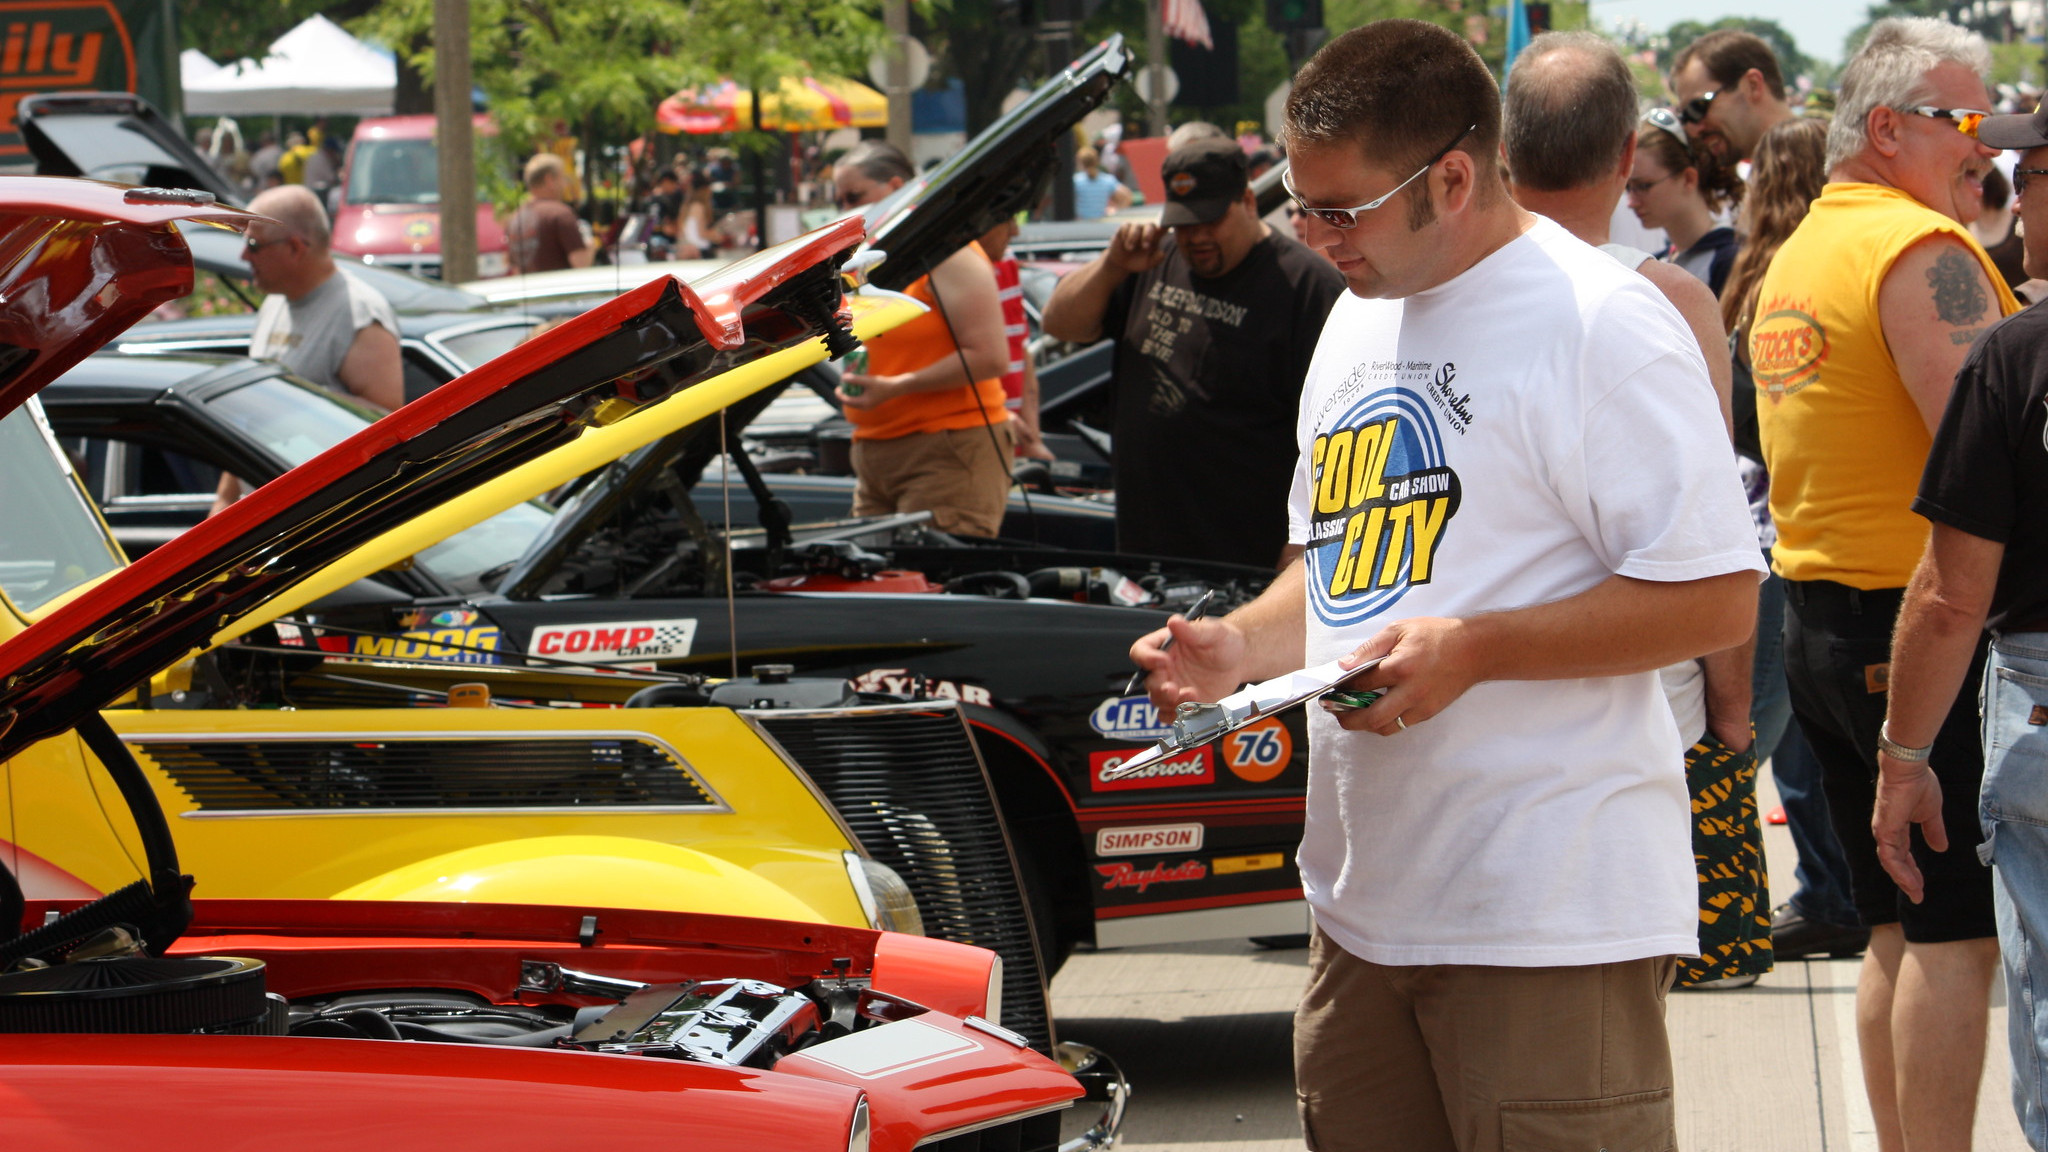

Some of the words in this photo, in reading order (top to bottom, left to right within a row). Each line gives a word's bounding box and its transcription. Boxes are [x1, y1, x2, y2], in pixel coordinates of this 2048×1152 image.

[0, 21, 103, 86] ily
[1401, 372, 1429, 380] UNION
[1435, 362, 1474, 425] Shoreline
[1313, 362, 1367, 432] iverside
[1426, 382, 1446, 410] CREDIT
[1444, 408, 1467, 436] UNION
[1308, 416, 1399, 519] COOL
[1389, 480, 1411, 501] CAR
[1411, 473, 1450, 496] SHOW
[1328, 496, 1450, 599] CITY
[352, 625, 500, 660] MOOG
[537, 627, 654, 655] COMP
[616, 644, 674, 657] CAMS
[880, 677, 995, 708] YEAR
[1096, 696, 1168, 730] CLEV
[1232, 727, 1282, 766] 76
[1104, 831, 1192, 849] SIMPSON
